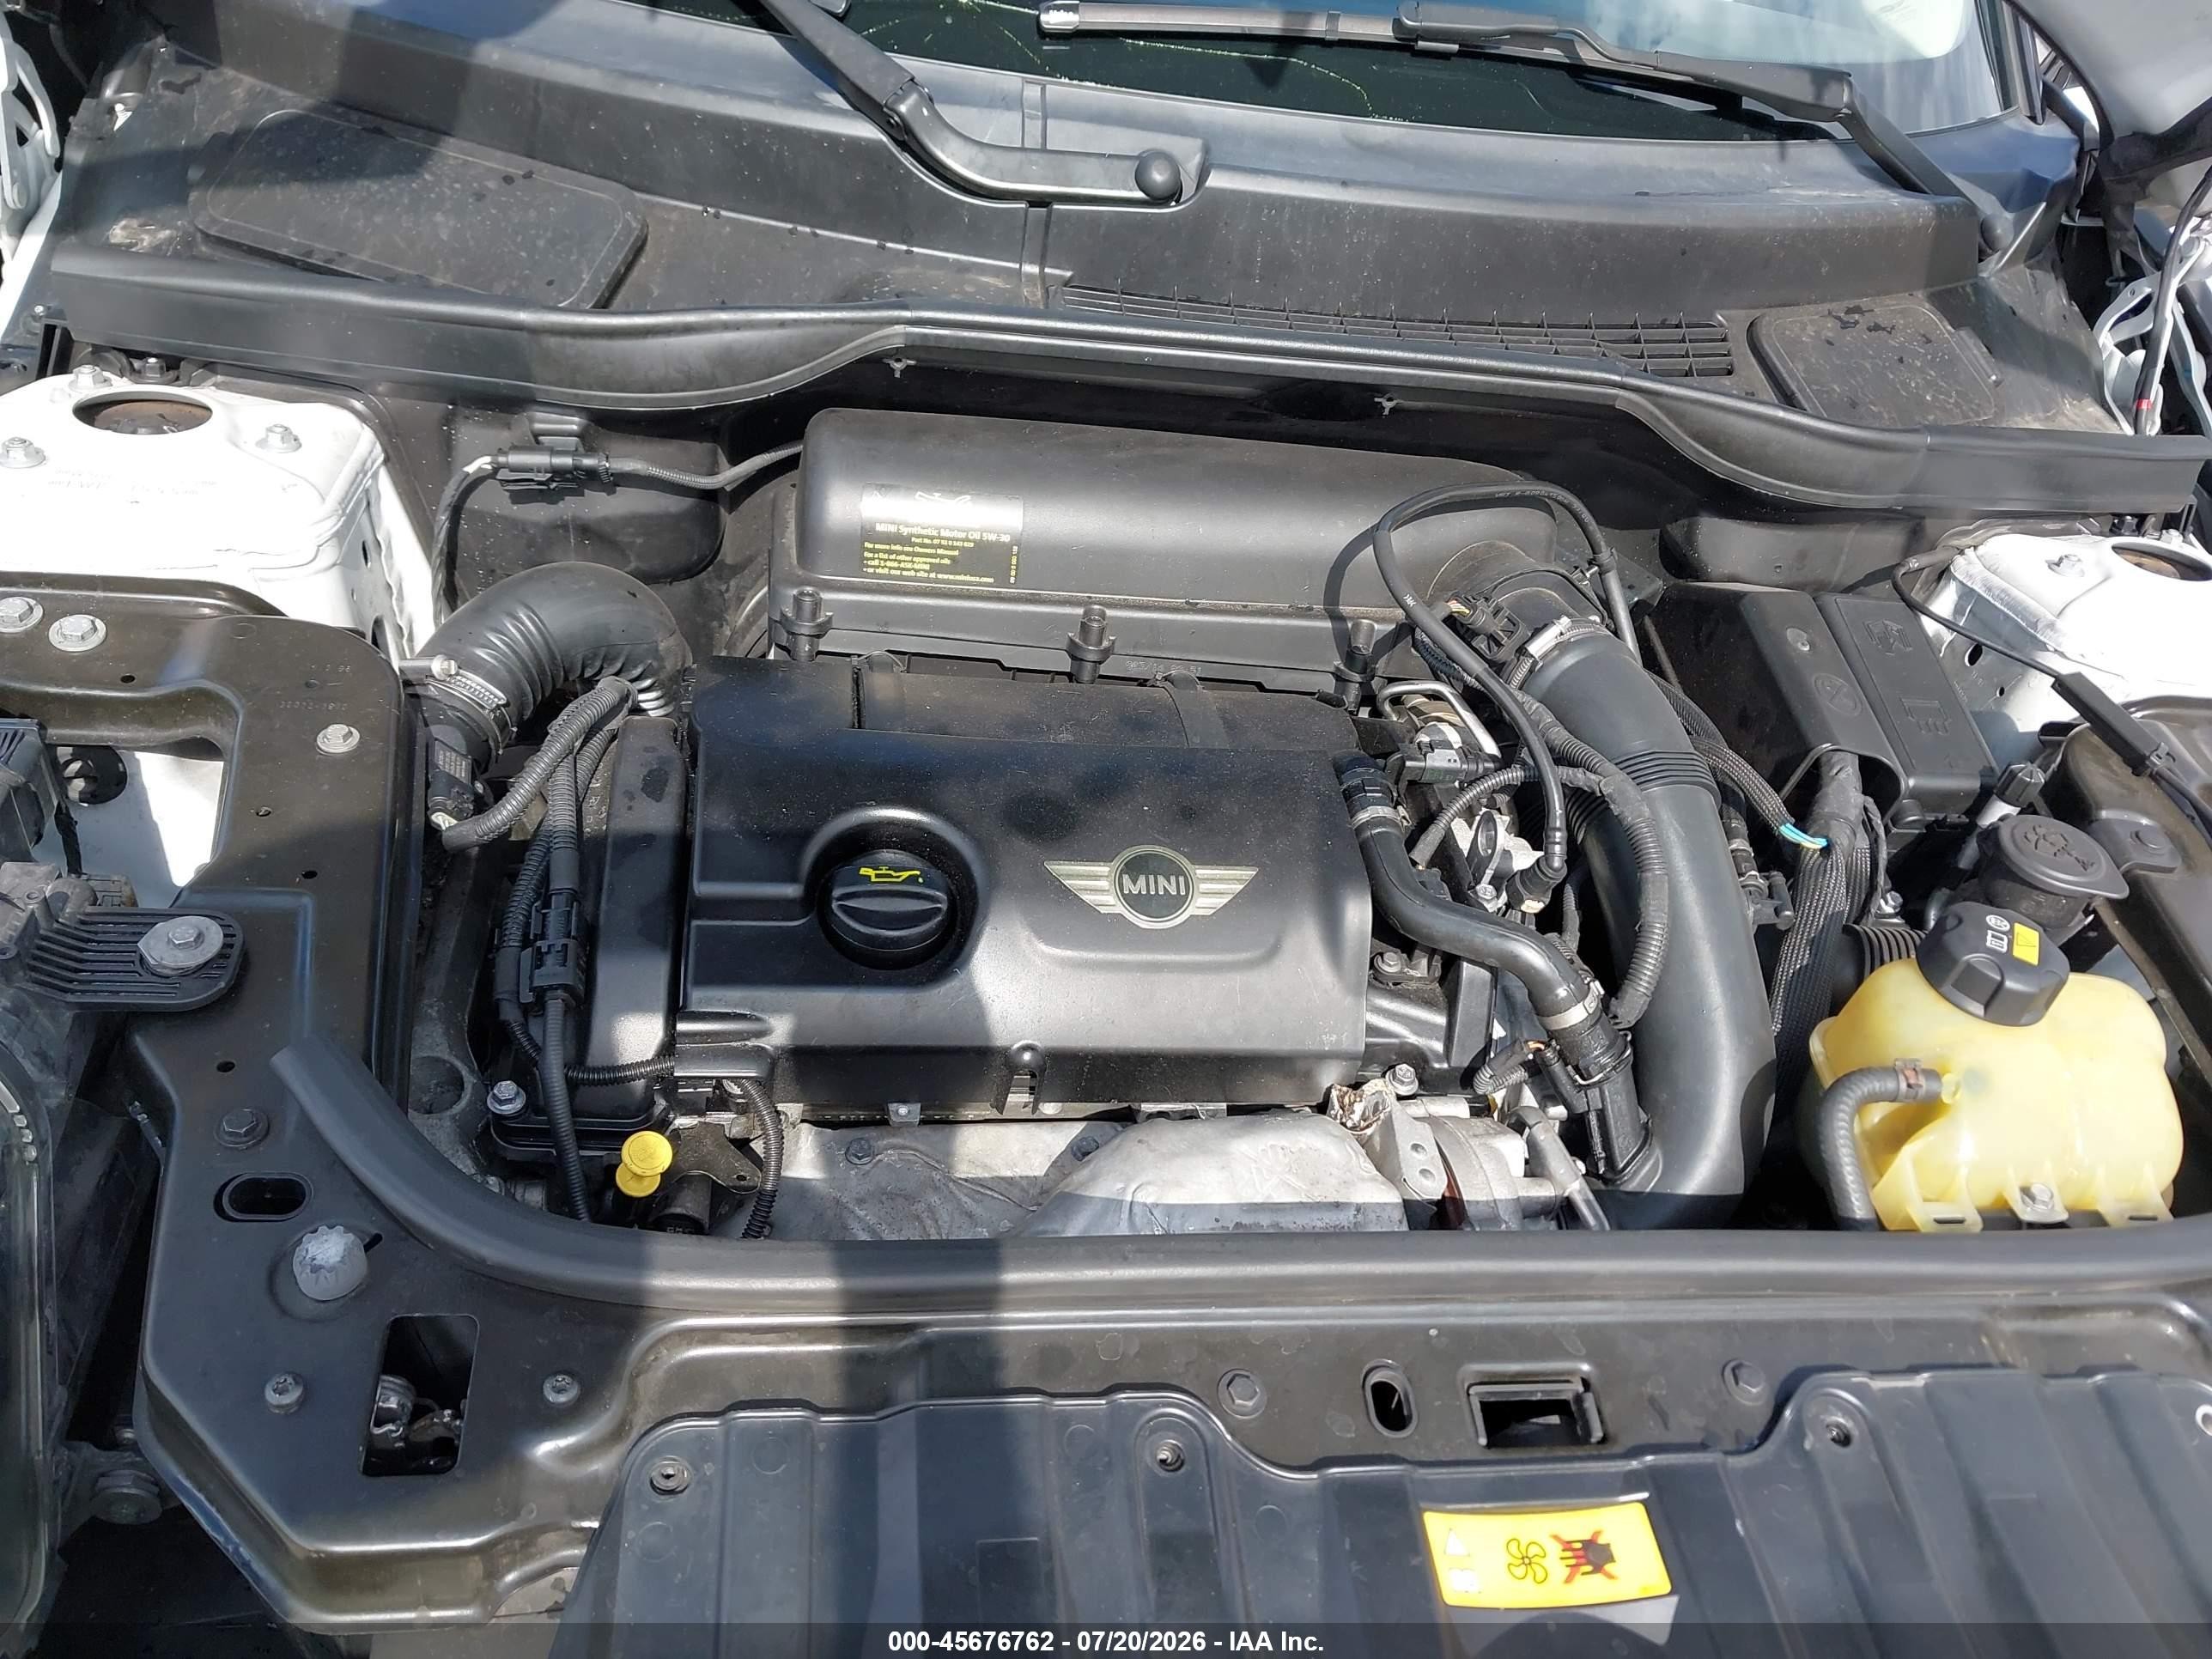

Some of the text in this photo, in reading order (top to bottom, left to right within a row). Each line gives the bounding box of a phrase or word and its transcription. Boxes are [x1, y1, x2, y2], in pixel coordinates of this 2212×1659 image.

[875, 522, 1011, 542] MINI Synthetic Motor Oil 5W-30
[1121, 873, 1186, 896] MINI
